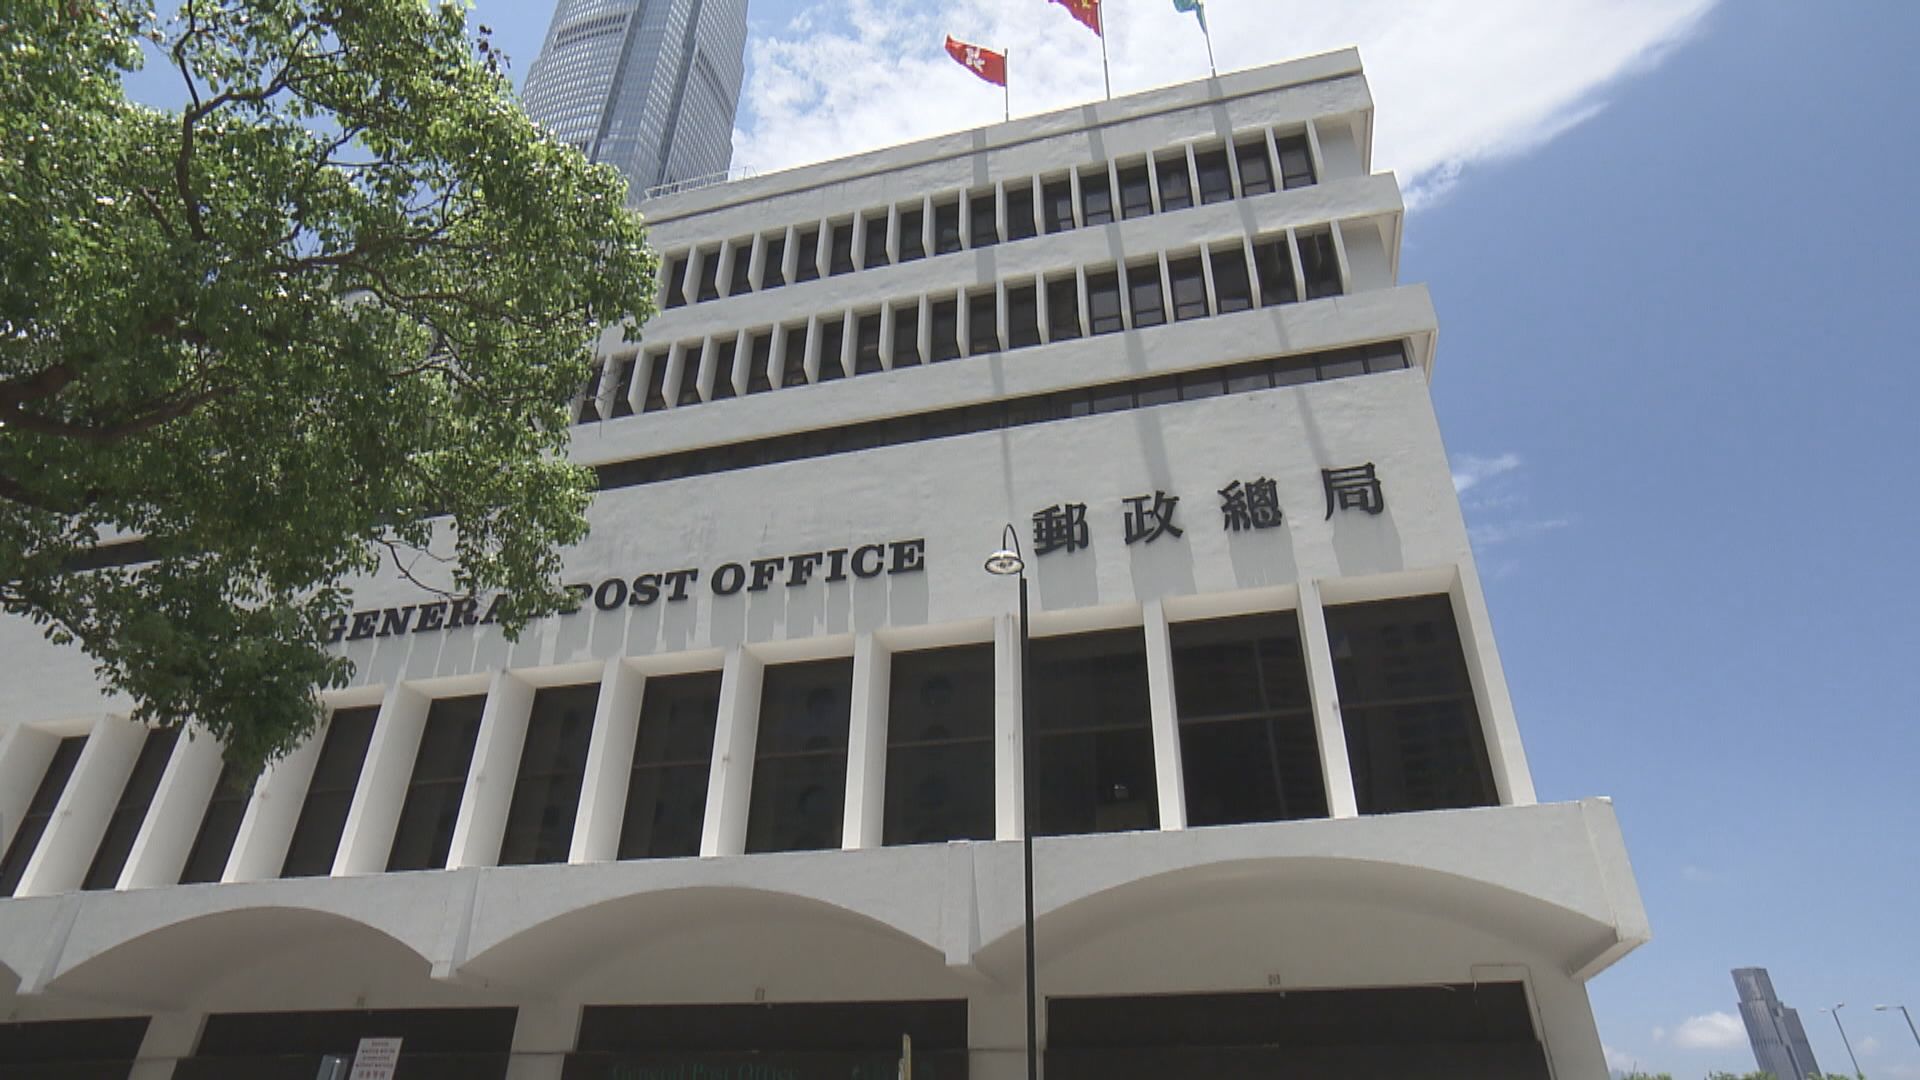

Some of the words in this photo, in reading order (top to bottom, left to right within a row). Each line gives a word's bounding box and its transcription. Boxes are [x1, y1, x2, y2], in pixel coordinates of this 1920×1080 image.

[1032, 461, 1386, 557] 郵政總局
[320, 590, 552, 645] GENERA
[558, 567, 699, 615] POST
[710, 537, 925, 596] OFFICE
